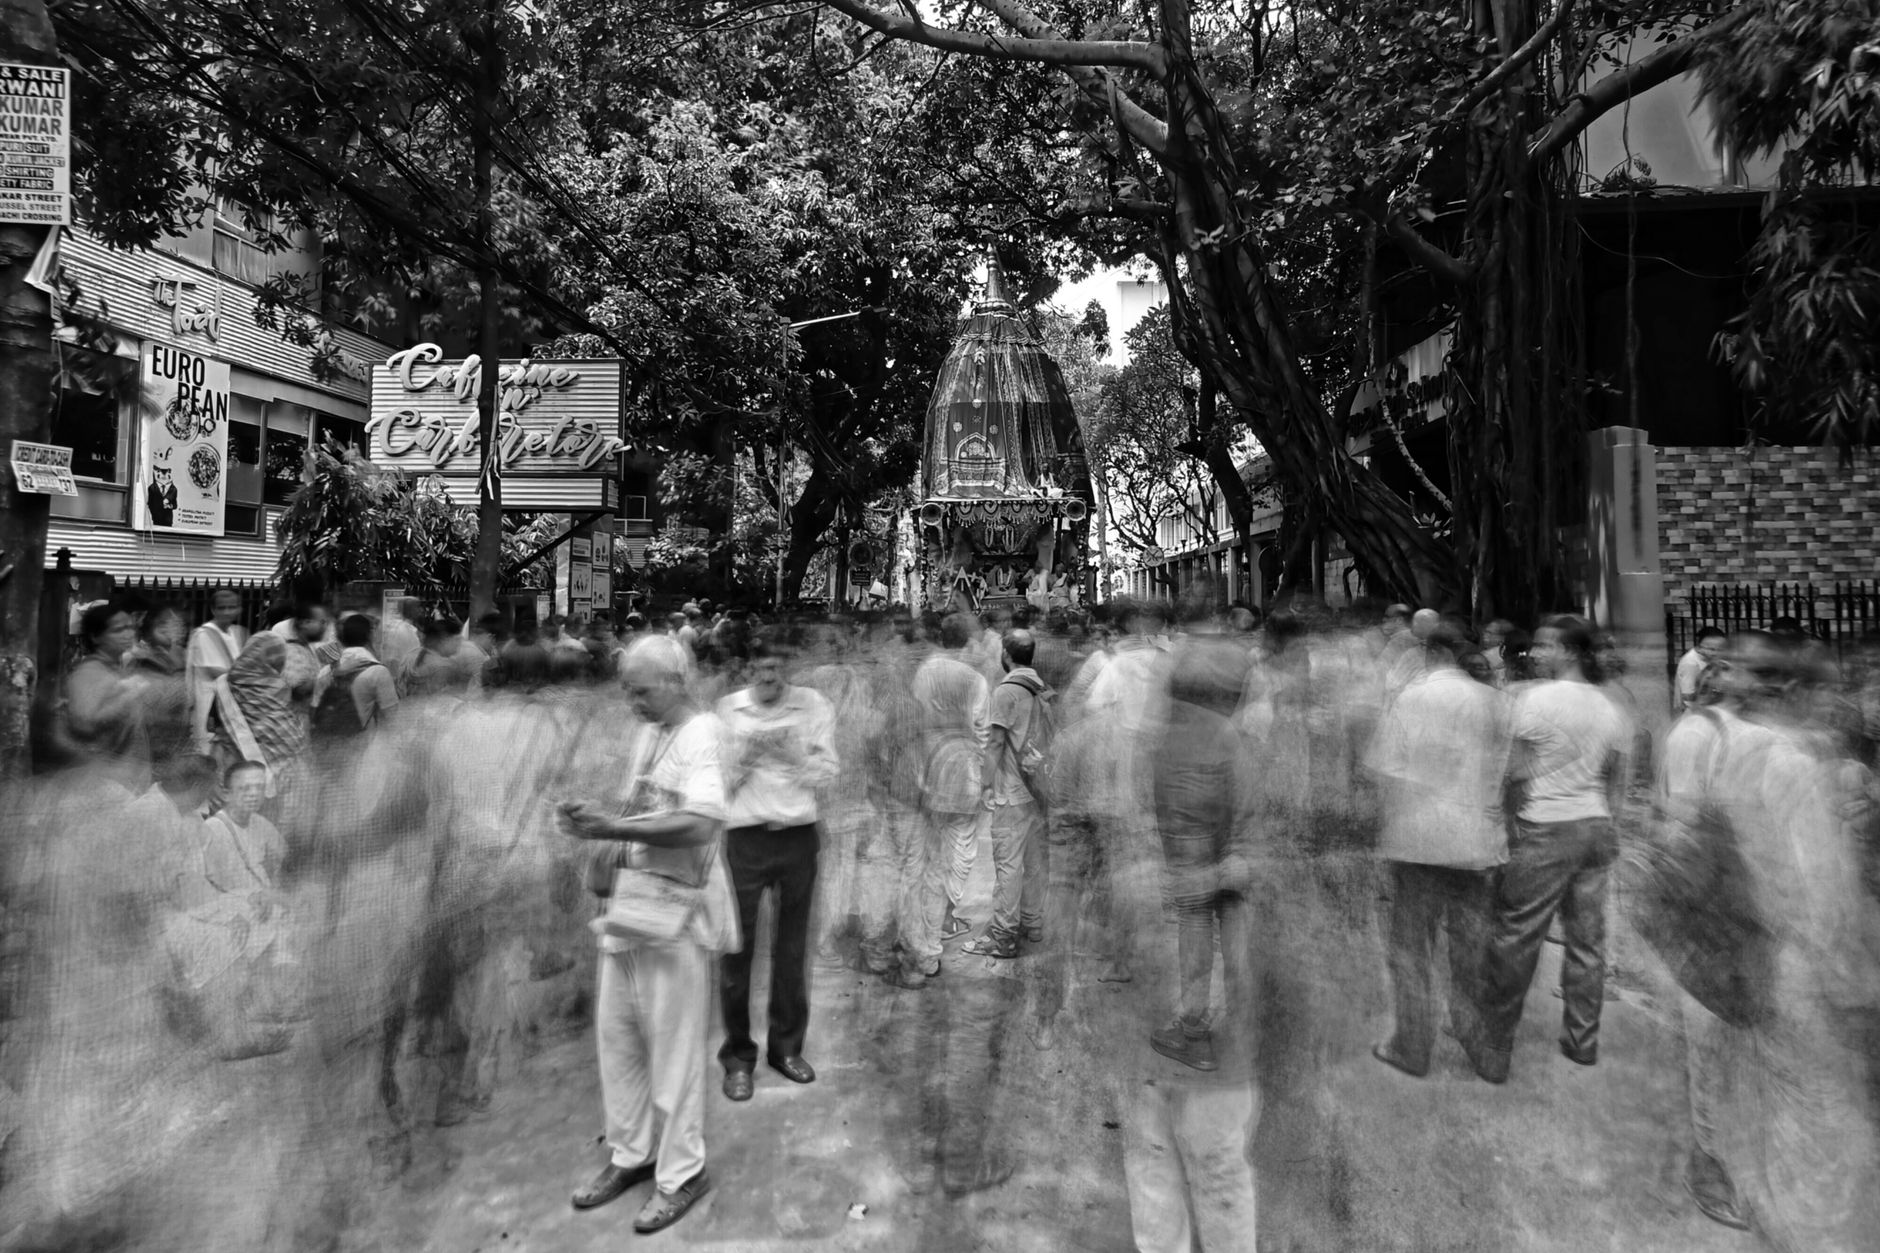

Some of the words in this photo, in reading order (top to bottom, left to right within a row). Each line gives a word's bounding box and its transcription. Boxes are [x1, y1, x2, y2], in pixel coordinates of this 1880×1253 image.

[18, 68, 62, 82] SALE
[0, 96, 64, 117] KUMAR
[25, 143, 49, 153] SUIT
[5, 167, 54, 178] SHIRTING
[20, 180, 53, 190] FABRIC
[25, 194, 62, 202] STREET
[29, 204, 62, 212] STREET
[22, 213, 62, 222] CROSSING
[151, 277, 176, 307] The
[155, 272, 222, 342] Toad
[152, 344, 206, 387] EURO
[177, 381, 228, 422] PEAN
[364, 407, 632, 470] Carbretors
